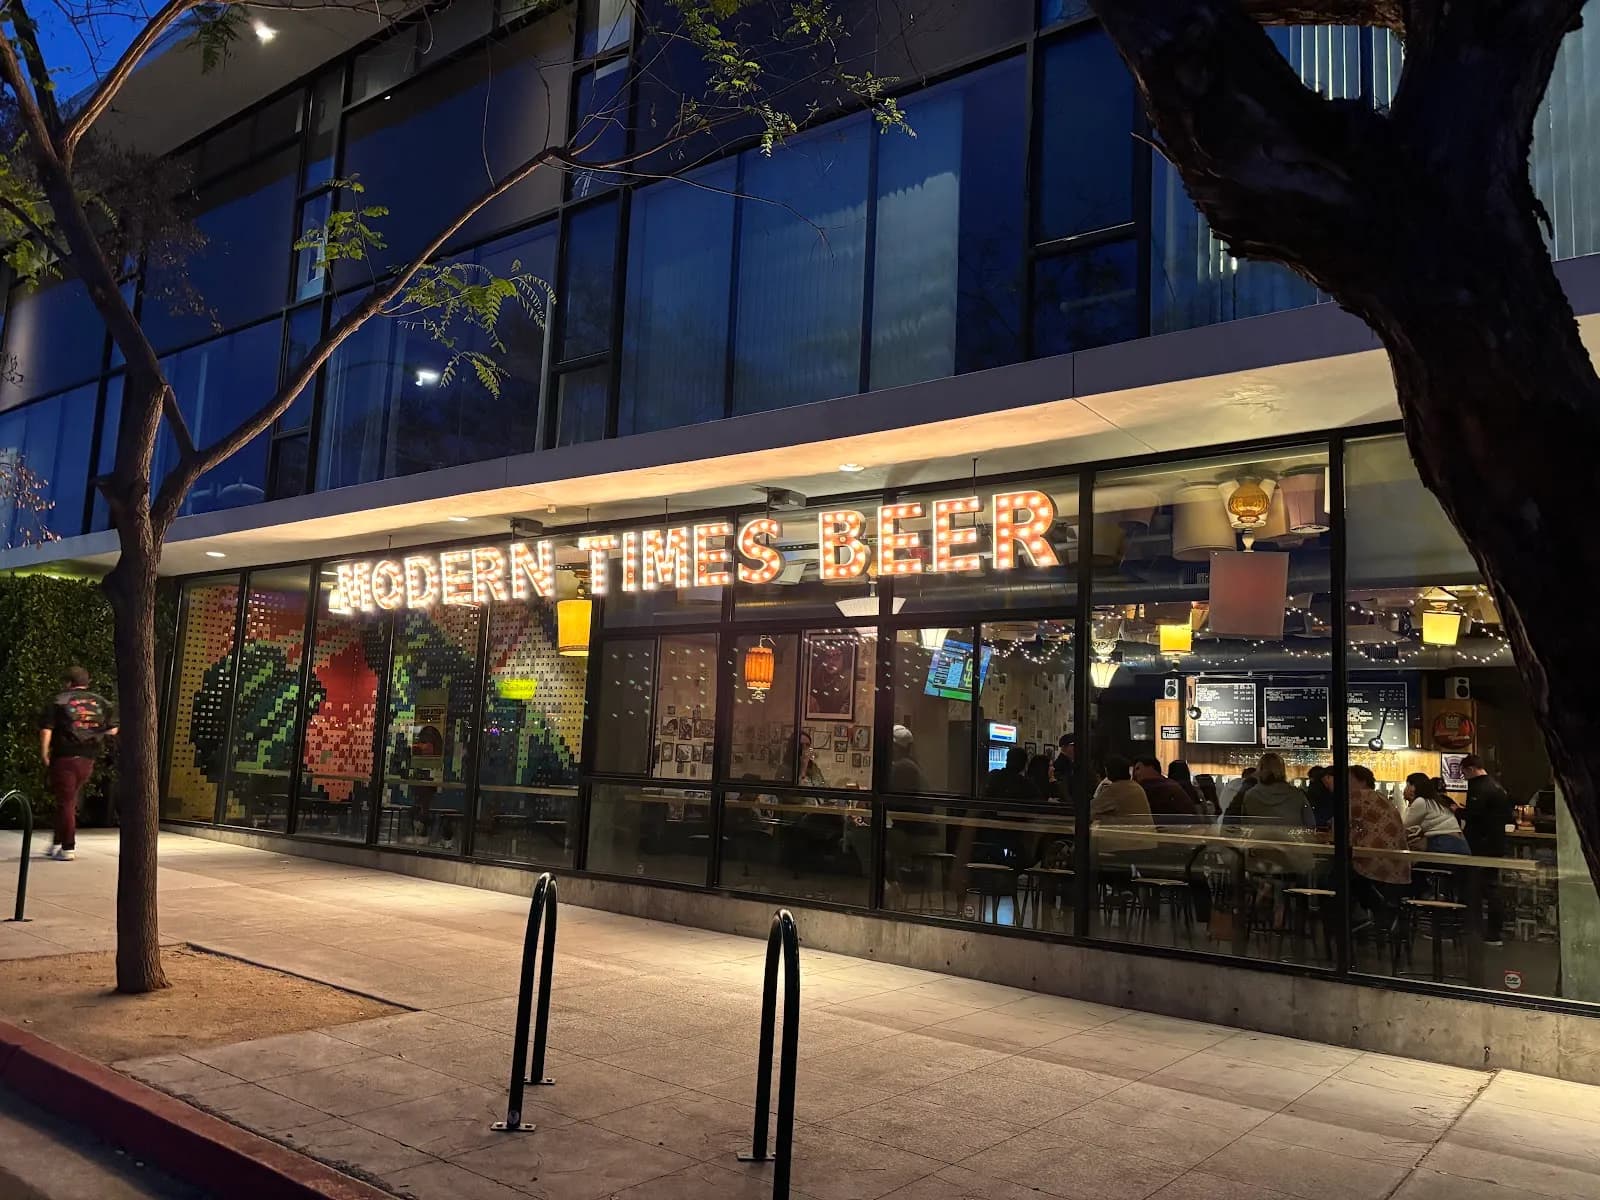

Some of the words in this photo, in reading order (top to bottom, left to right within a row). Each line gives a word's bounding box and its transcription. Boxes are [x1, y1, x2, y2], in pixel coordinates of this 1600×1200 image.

[337, 540, 554, 612] MODERN
[578, 519, 783, 595] TIMES
[818, 490, 1058, 580] BEER
